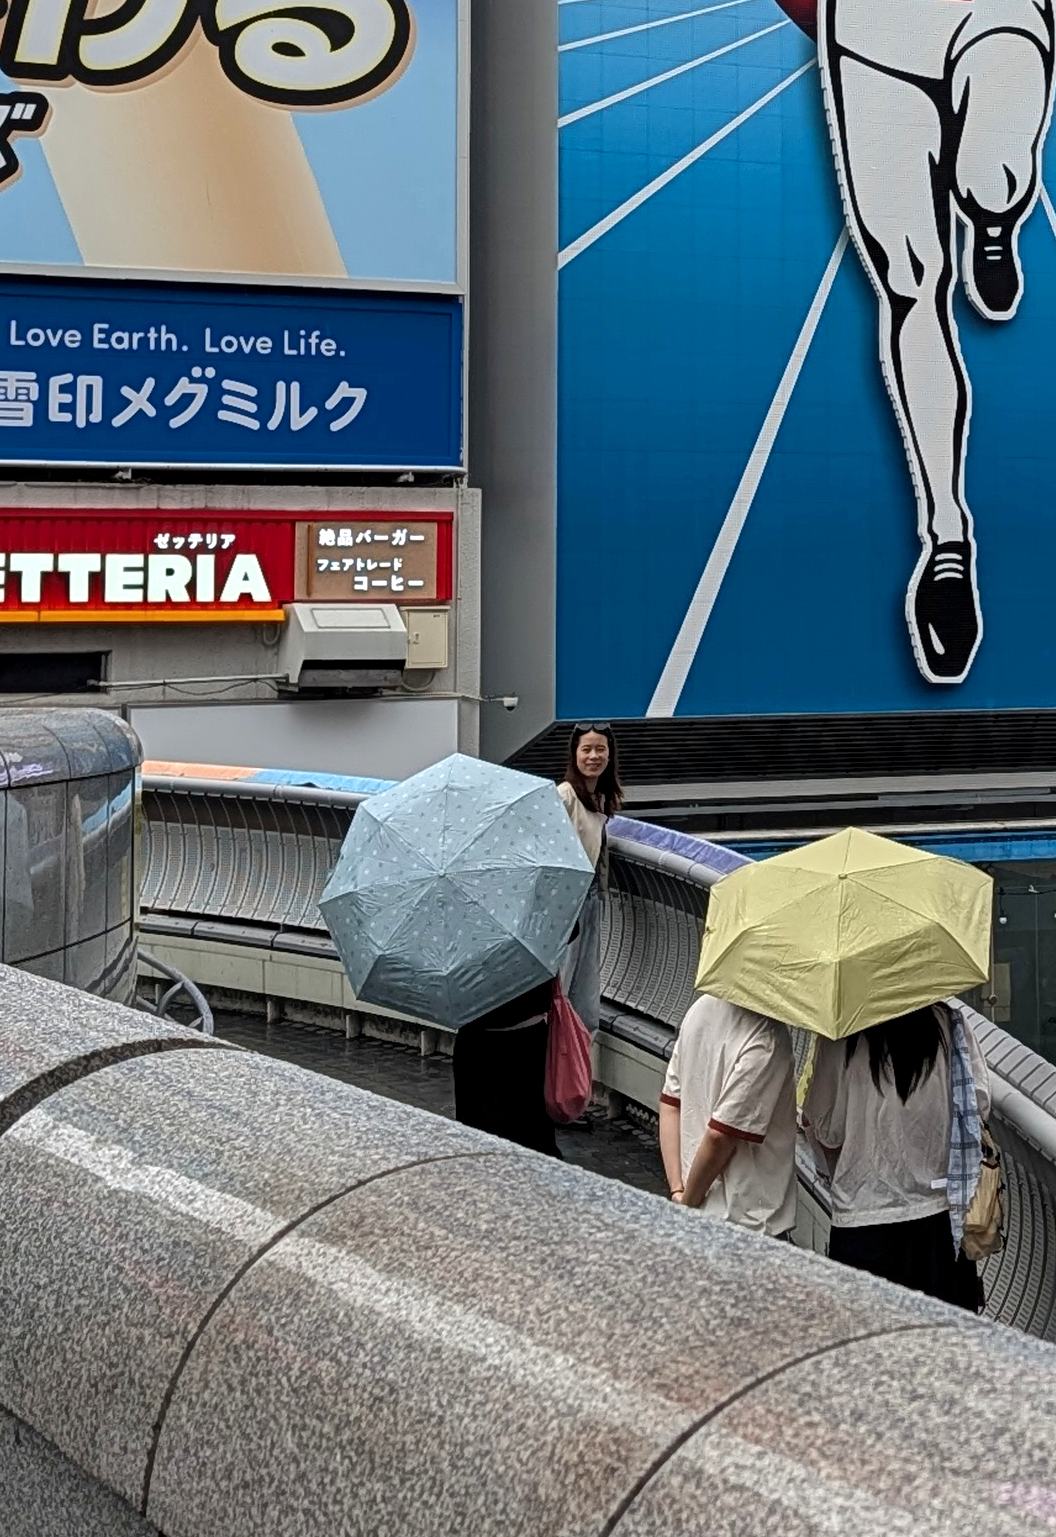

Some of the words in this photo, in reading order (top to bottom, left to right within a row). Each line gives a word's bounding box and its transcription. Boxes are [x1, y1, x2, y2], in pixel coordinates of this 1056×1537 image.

[10, 320, 83, 349] Love
[92, 324, 189, 352] Earth.
[205, 327, 273, 354] Love
[283, 330, 347, 357] Life.
[0, 366, 368, 432] 雪印メグミルク
[153, 532, 236, 551] ゼッテリア
[318, 528, 425, 547] 絶品バーガー
[317, 557, 403, 572] フェアトレード
[0, 553, 272, 603] TTERIA
[353, 574, 424, 591] コーヒー
